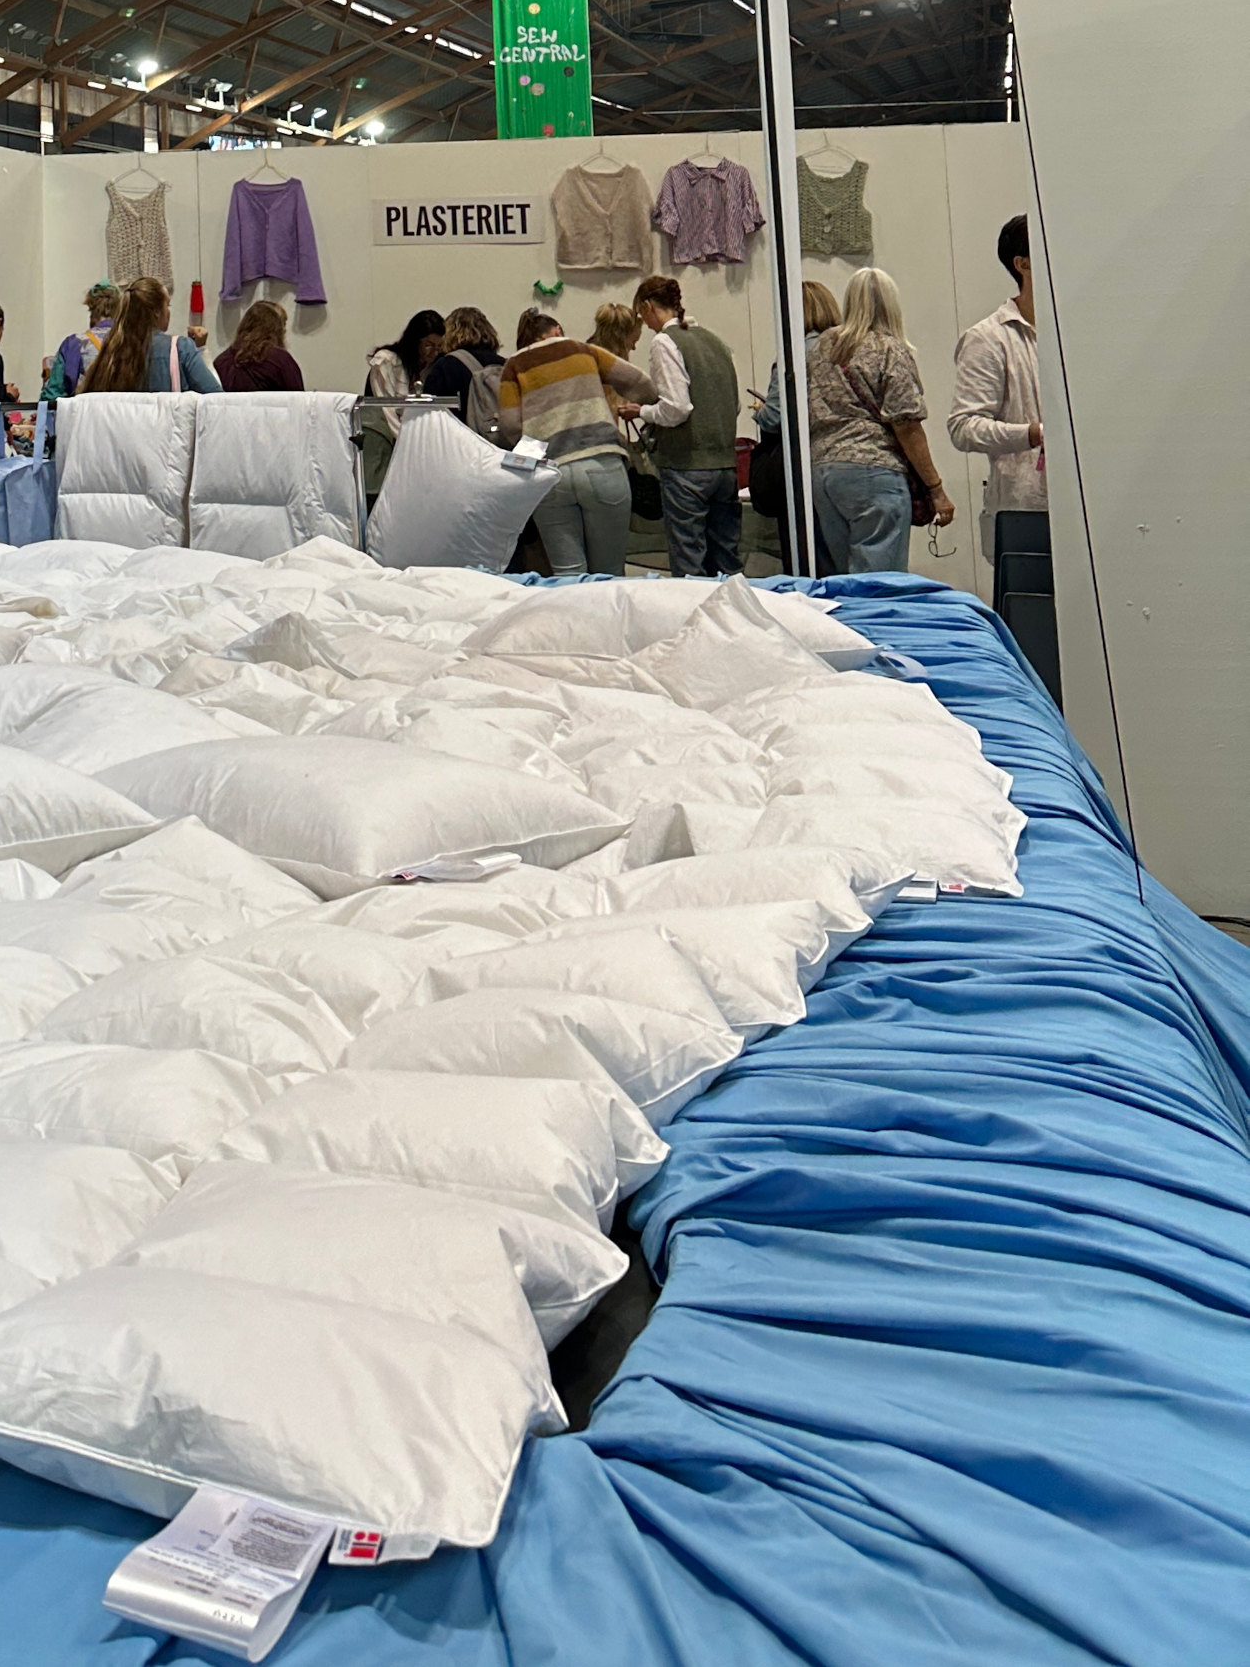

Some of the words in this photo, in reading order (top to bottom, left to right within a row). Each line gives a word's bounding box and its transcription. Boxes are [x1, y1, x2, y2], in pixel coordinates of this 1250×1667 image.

[517, 27, 557, 44] SEW
[499, 44, 586, 63] CENTRAL
[385, 203, 531, 237] PLASTERIET
